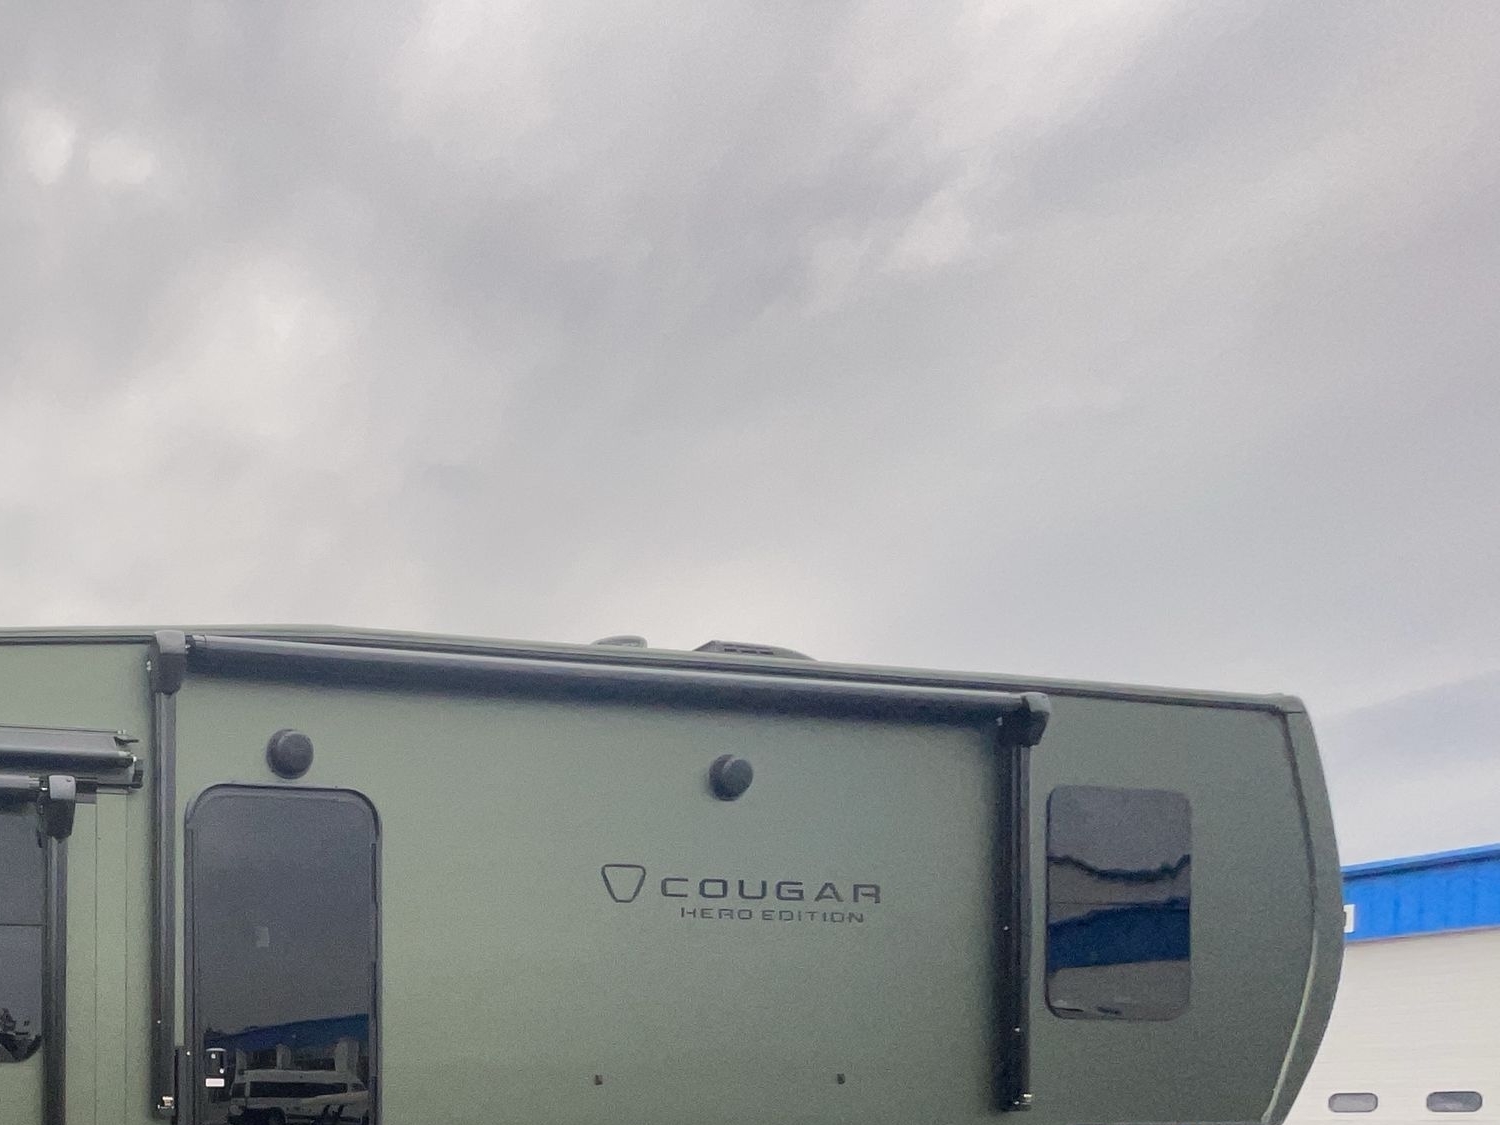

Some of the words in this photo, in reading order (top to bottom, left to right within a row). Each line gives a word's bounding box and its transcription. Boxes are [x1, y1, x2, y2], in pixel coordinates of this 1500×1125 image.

[660, 877, 881, 904] COUGAR
[680, 906, 753, 920] HERO
[761, 908, 865, 923] EDITION
